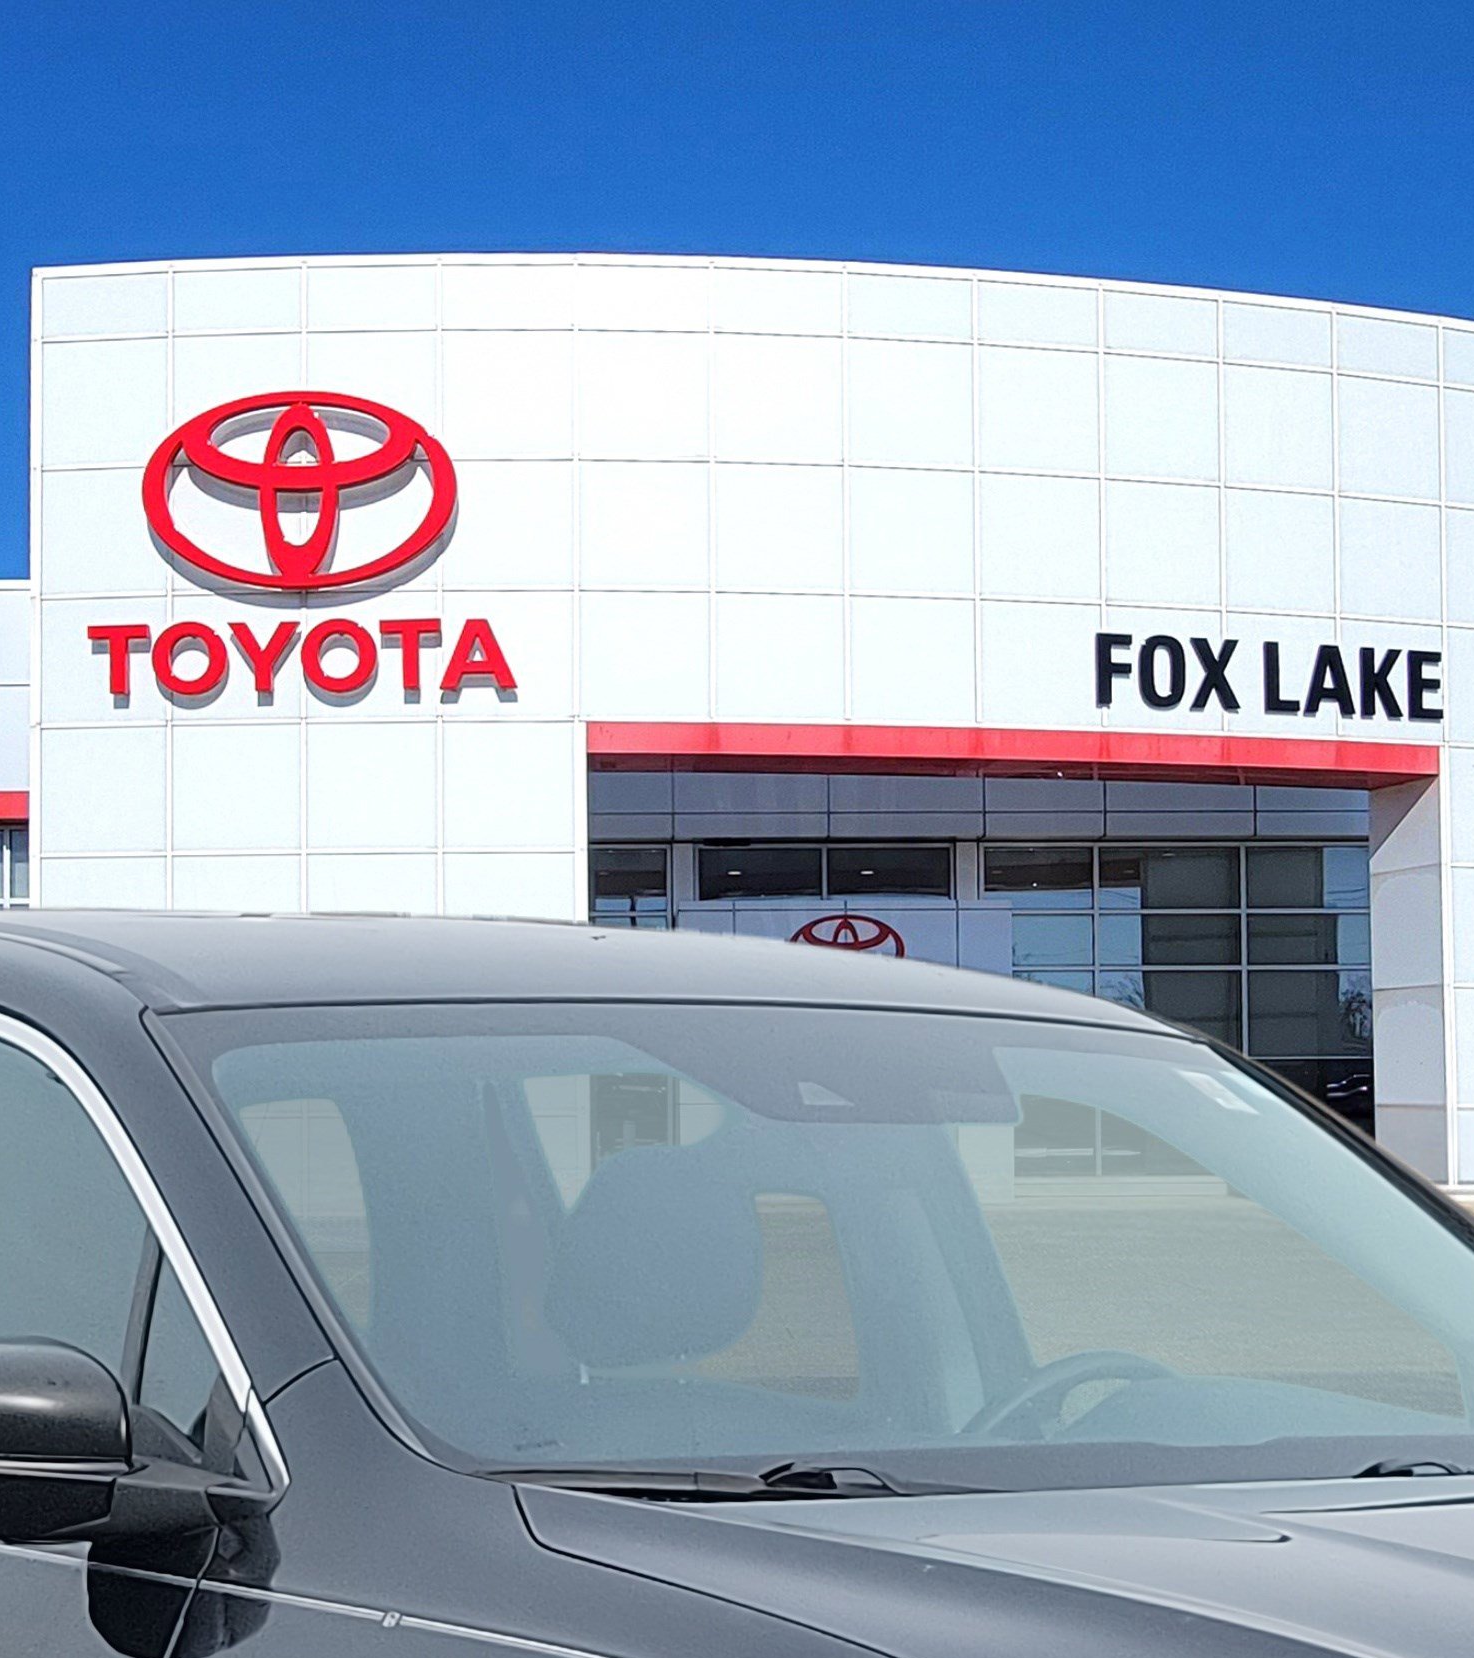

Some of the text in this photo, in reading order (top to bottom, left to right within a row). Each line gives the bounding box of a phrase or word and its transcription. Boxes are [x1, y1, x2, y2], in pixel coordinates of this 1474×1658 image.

[87, 618, 518, 697] TOYOTA
[1095, 632, 1445, 721] FOX LAKE
